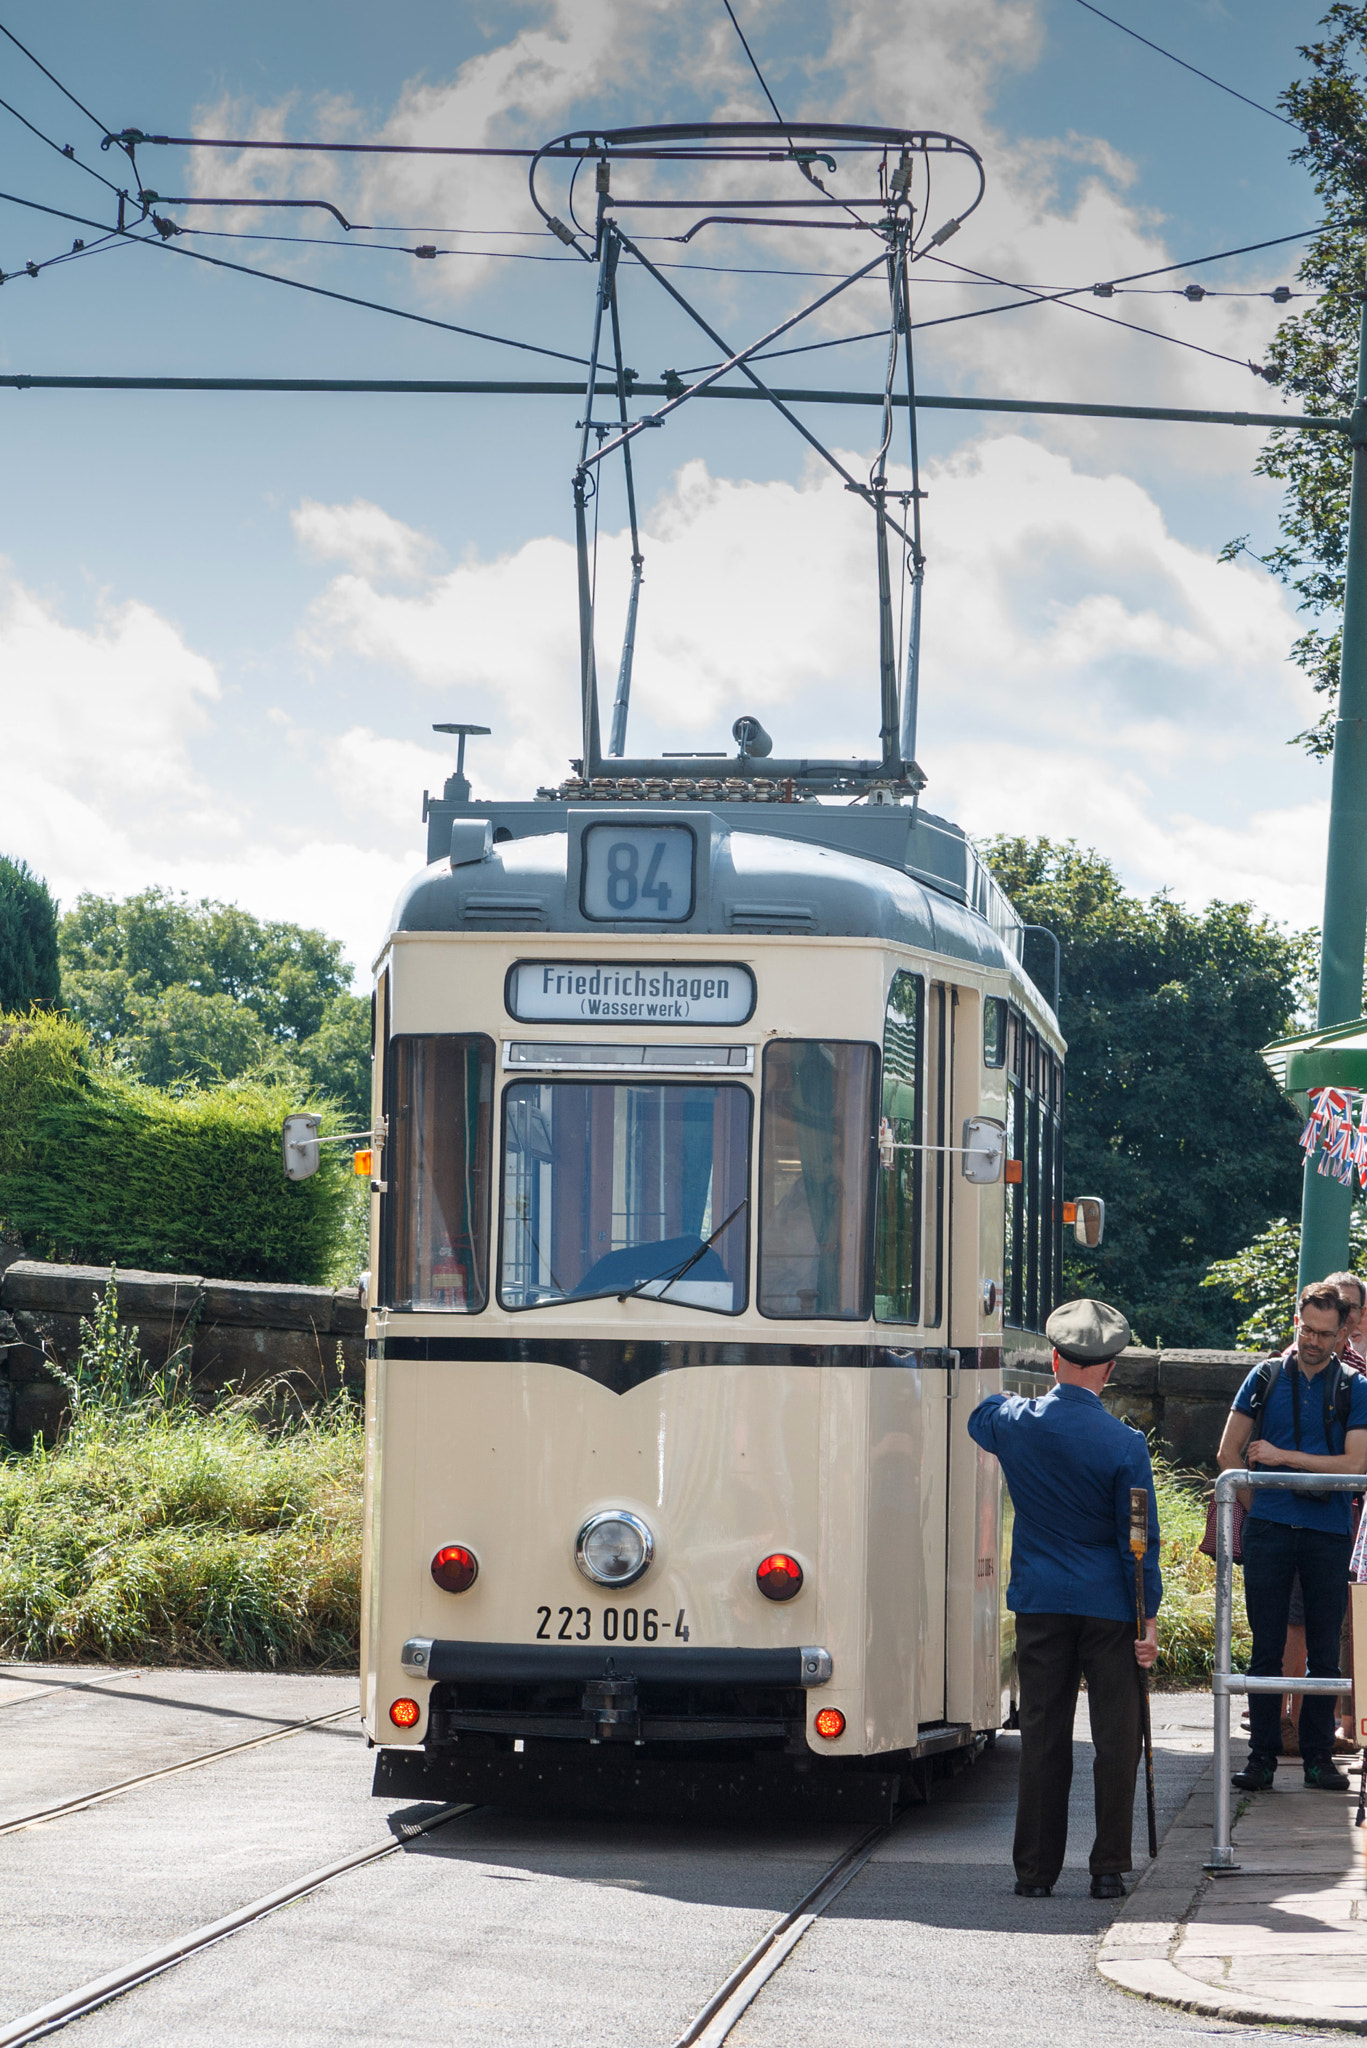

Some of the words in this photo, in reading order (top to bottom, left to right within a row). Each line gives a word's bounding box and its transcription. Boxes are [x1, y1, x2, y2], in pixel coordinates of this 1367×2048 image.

[607, 842, 672, 911] 84
[543, 968, 729, 1000] Friedrichshagen
[580, 998, 690, 1017] (Wasserwerk)
[536, 1606, 591, 1640] 223
[603, 1607, 690, 1642] 006-4
